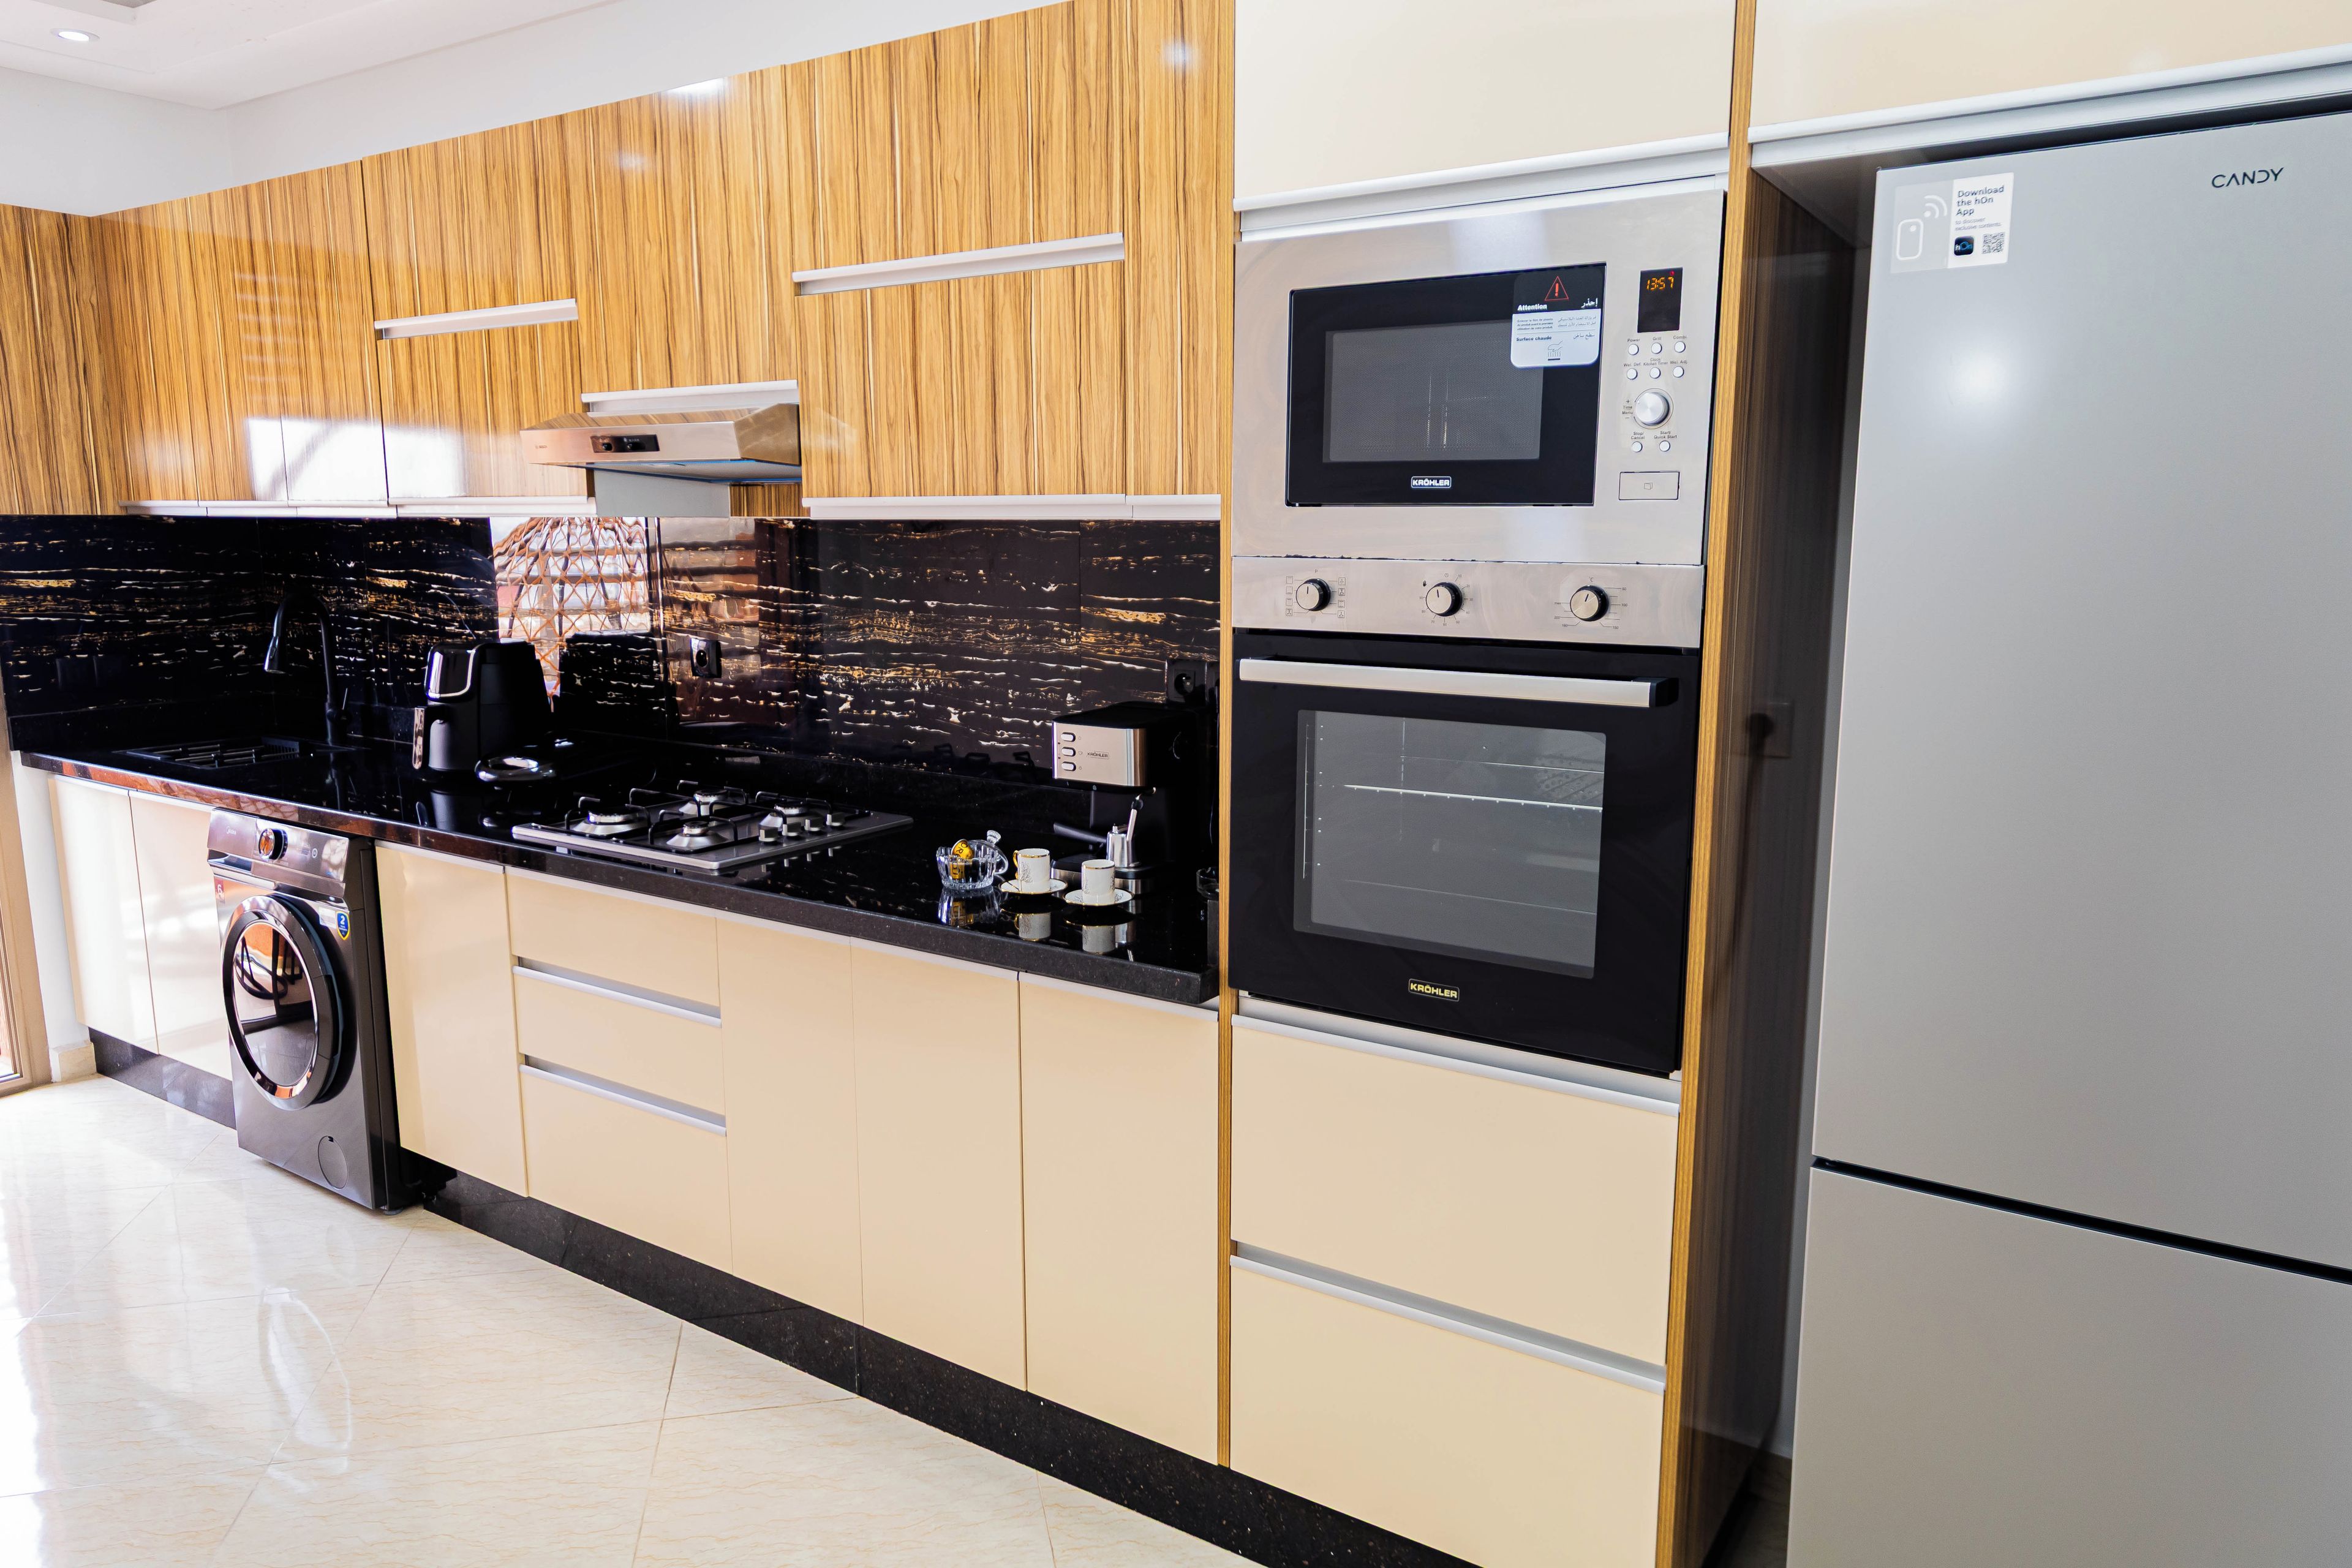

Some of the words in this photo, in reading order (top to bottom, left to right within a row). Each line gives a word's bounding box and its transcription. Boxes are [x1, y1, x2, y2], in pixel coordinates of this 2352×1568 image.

[2212, 167, 2285, 188] CANDY
[1957, 185, 2005, 197] Download
[1975, 196, 1994, 205] hOn
[1646, 277, 1674, 290] 13:57
[217, 884, 222, 895] 6
[340, 915, 345, 925] 2
[1410, 982, 1458, 998] KRÖHLER
